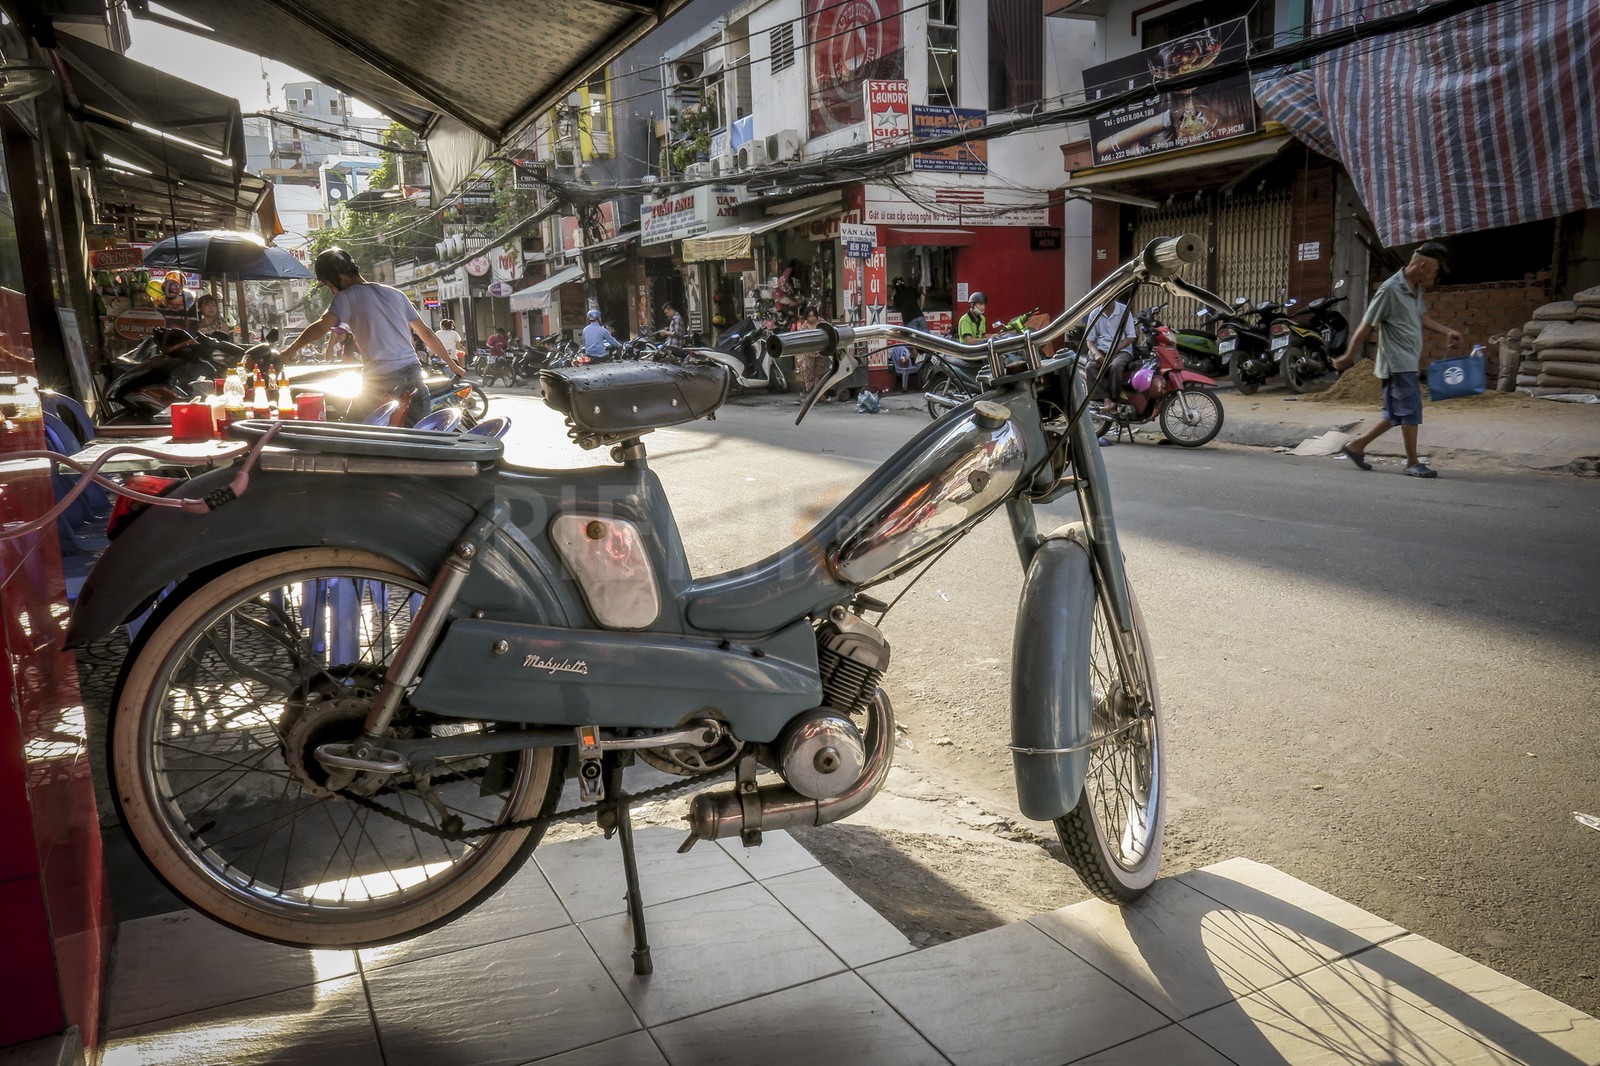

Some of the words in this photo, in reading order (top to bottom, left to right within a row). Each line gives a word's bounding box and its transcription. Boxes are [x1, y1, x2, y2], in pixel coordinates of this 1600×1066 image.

[871, 82, 908, 91] STAR
[871, 92, 908, 104] LAUNDRY
[1104, 119, 1112, 127] Tel
[1101, 153, 1111, 162] Add
[1115, 151, 1125, 159] 222
[1217, 124, 1245, 136] TP.HCM
[651, 198, 673, 218] TUẤN
[674, 196, 694, 212] ANH
[868, 210, 880, 222] Giặt
[886, 212, 896, 220] cao
[897, 209, 906, 222] cấp
[907, 211, 919, 223] công
[1034, 230, 1060, 238] TATTOO
[861, 243, 869, 251] 222
[97, 251, 129, 266] Oishi
[871, 274, 880, 293] ỦI
[131, 325, 145, 333] SINH
[523, 654, 588, 674] Mobylette
